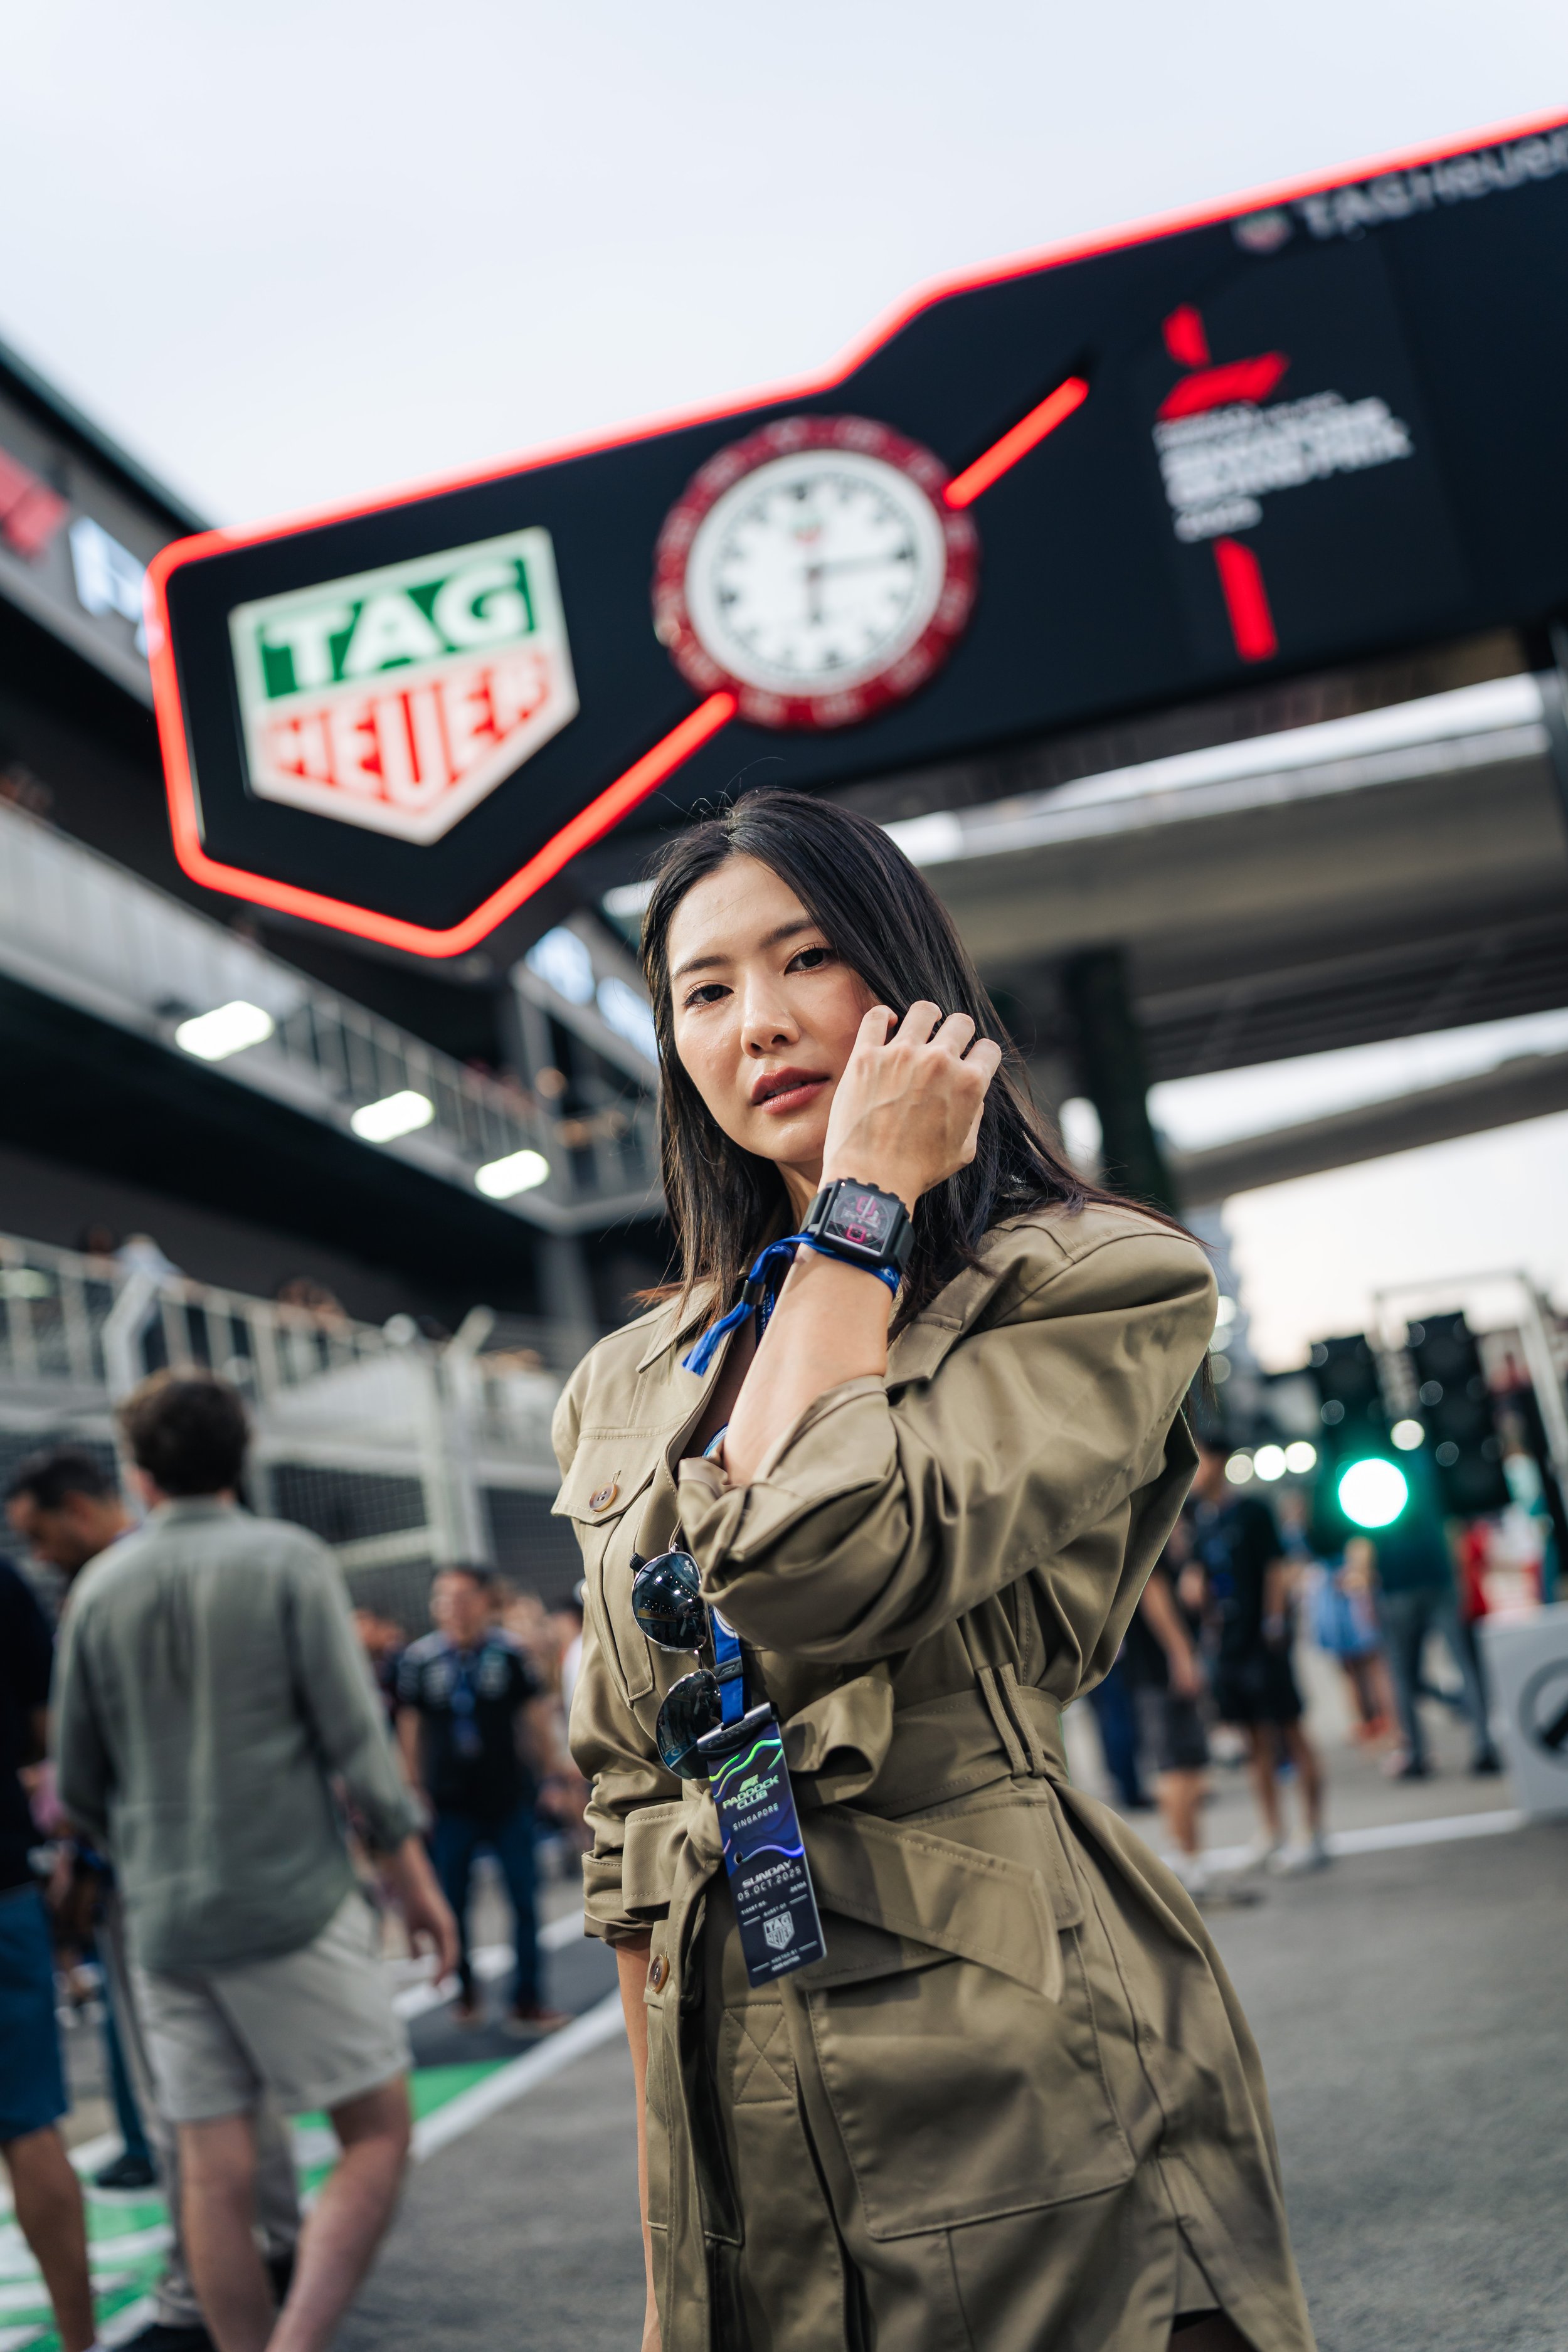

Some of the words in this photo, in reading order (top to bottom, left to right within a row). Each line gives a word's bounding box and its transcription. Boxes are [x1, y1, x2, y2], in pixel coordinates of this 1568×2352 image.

[259, 556, 533, 689] TAG
[266, 646, 553, 810] HEUER
[723, 1774, 780, 1809] PADDOCK
[736, 1789, 768, 1811] CLUB
[733, 1803, 779, 1831] SINGAPORE
[742, 1859, 792, 1888] SUNDAY
[766, 1914, 790, 1933] TAG
[767, 1923, 792, 1946] HEUER
